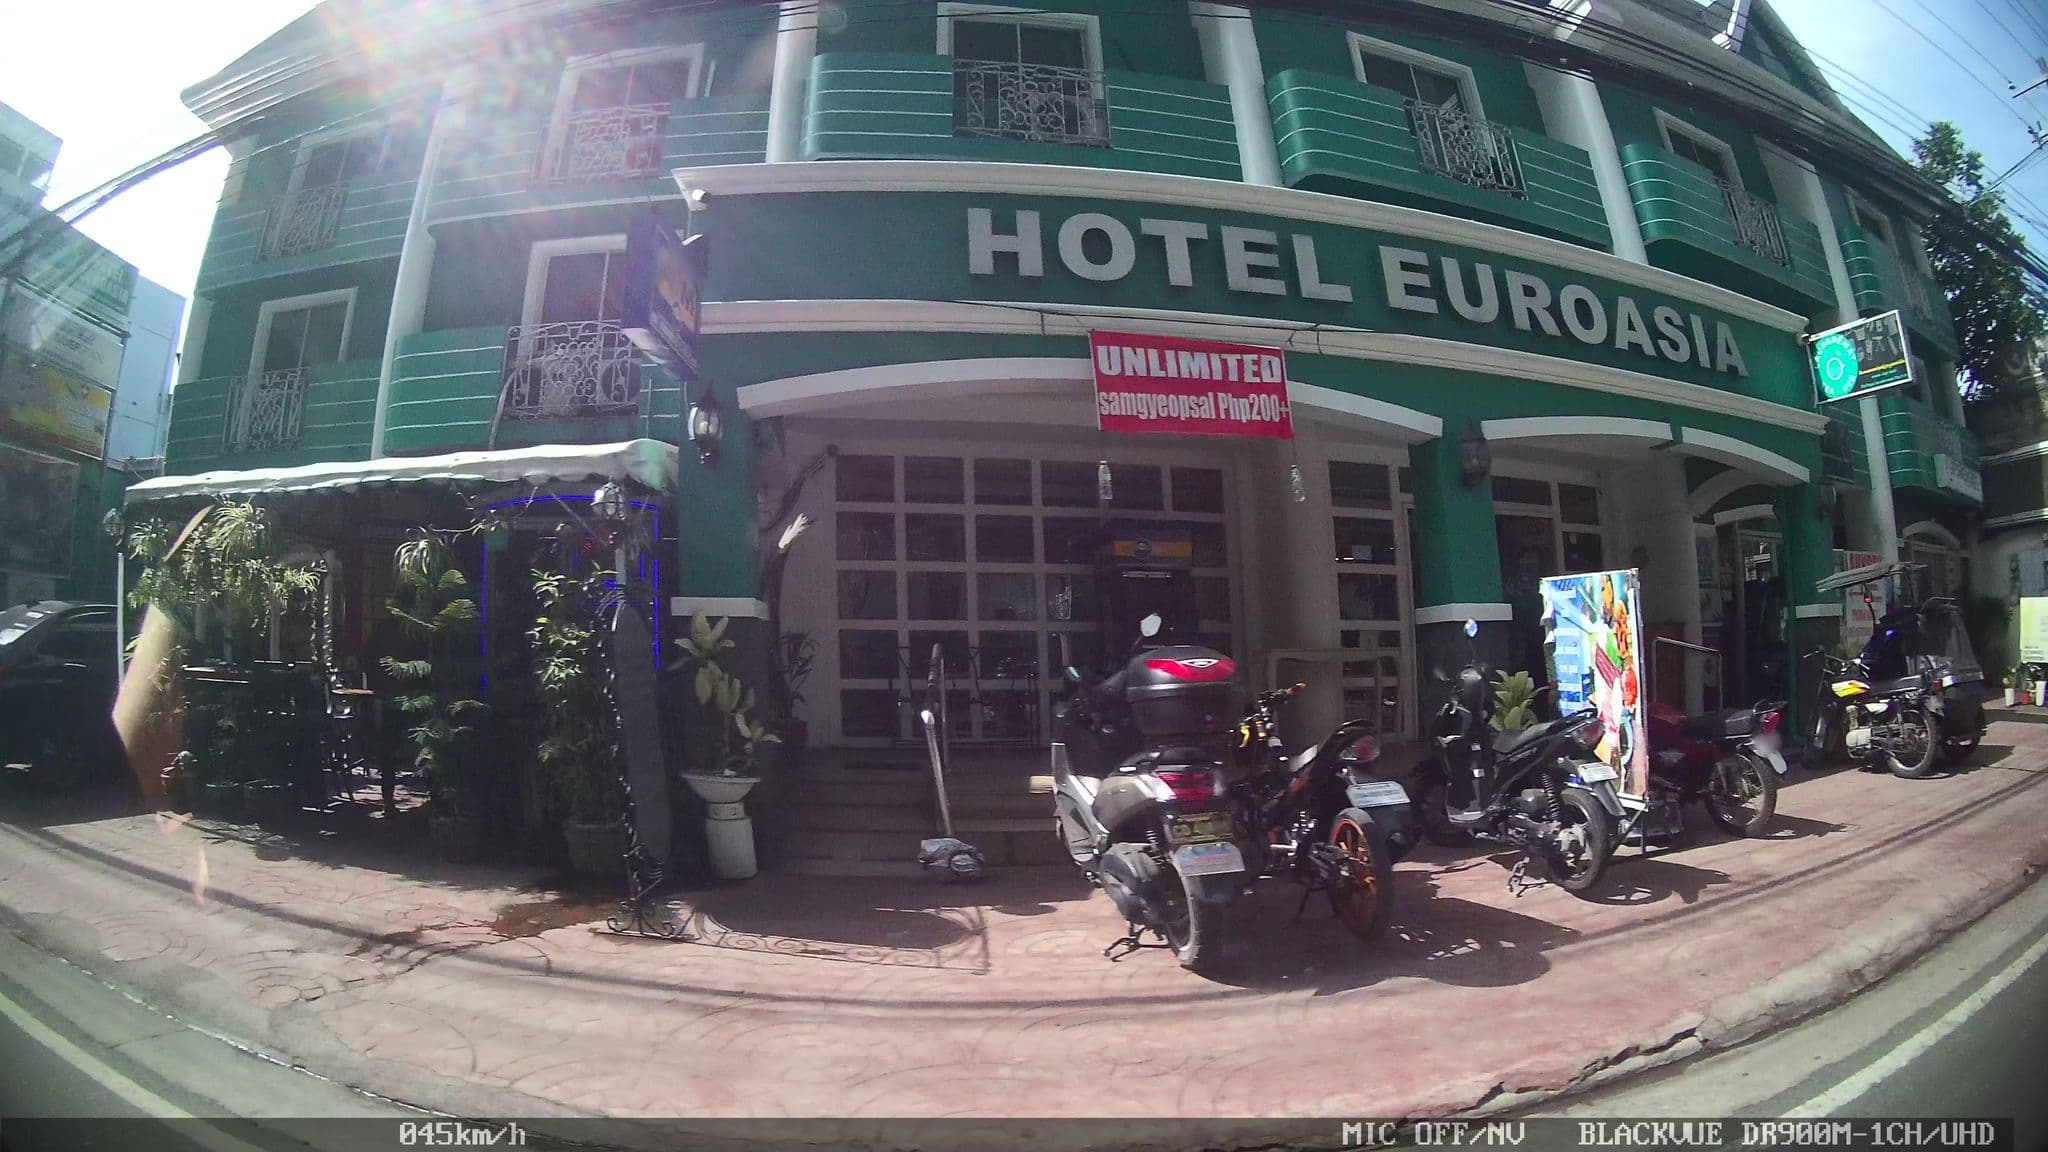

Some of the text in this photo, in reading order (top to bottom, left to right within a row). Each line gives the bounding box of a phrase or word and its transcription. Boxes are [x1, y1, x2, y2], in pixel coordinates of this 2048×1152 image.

[967, 207, 1749, 377] HOTEL EUROASIA
[1096, 345, 1283, 384] UNLIMITED
[1100, 391, 1289, 423] samgyeopsal Php200+
